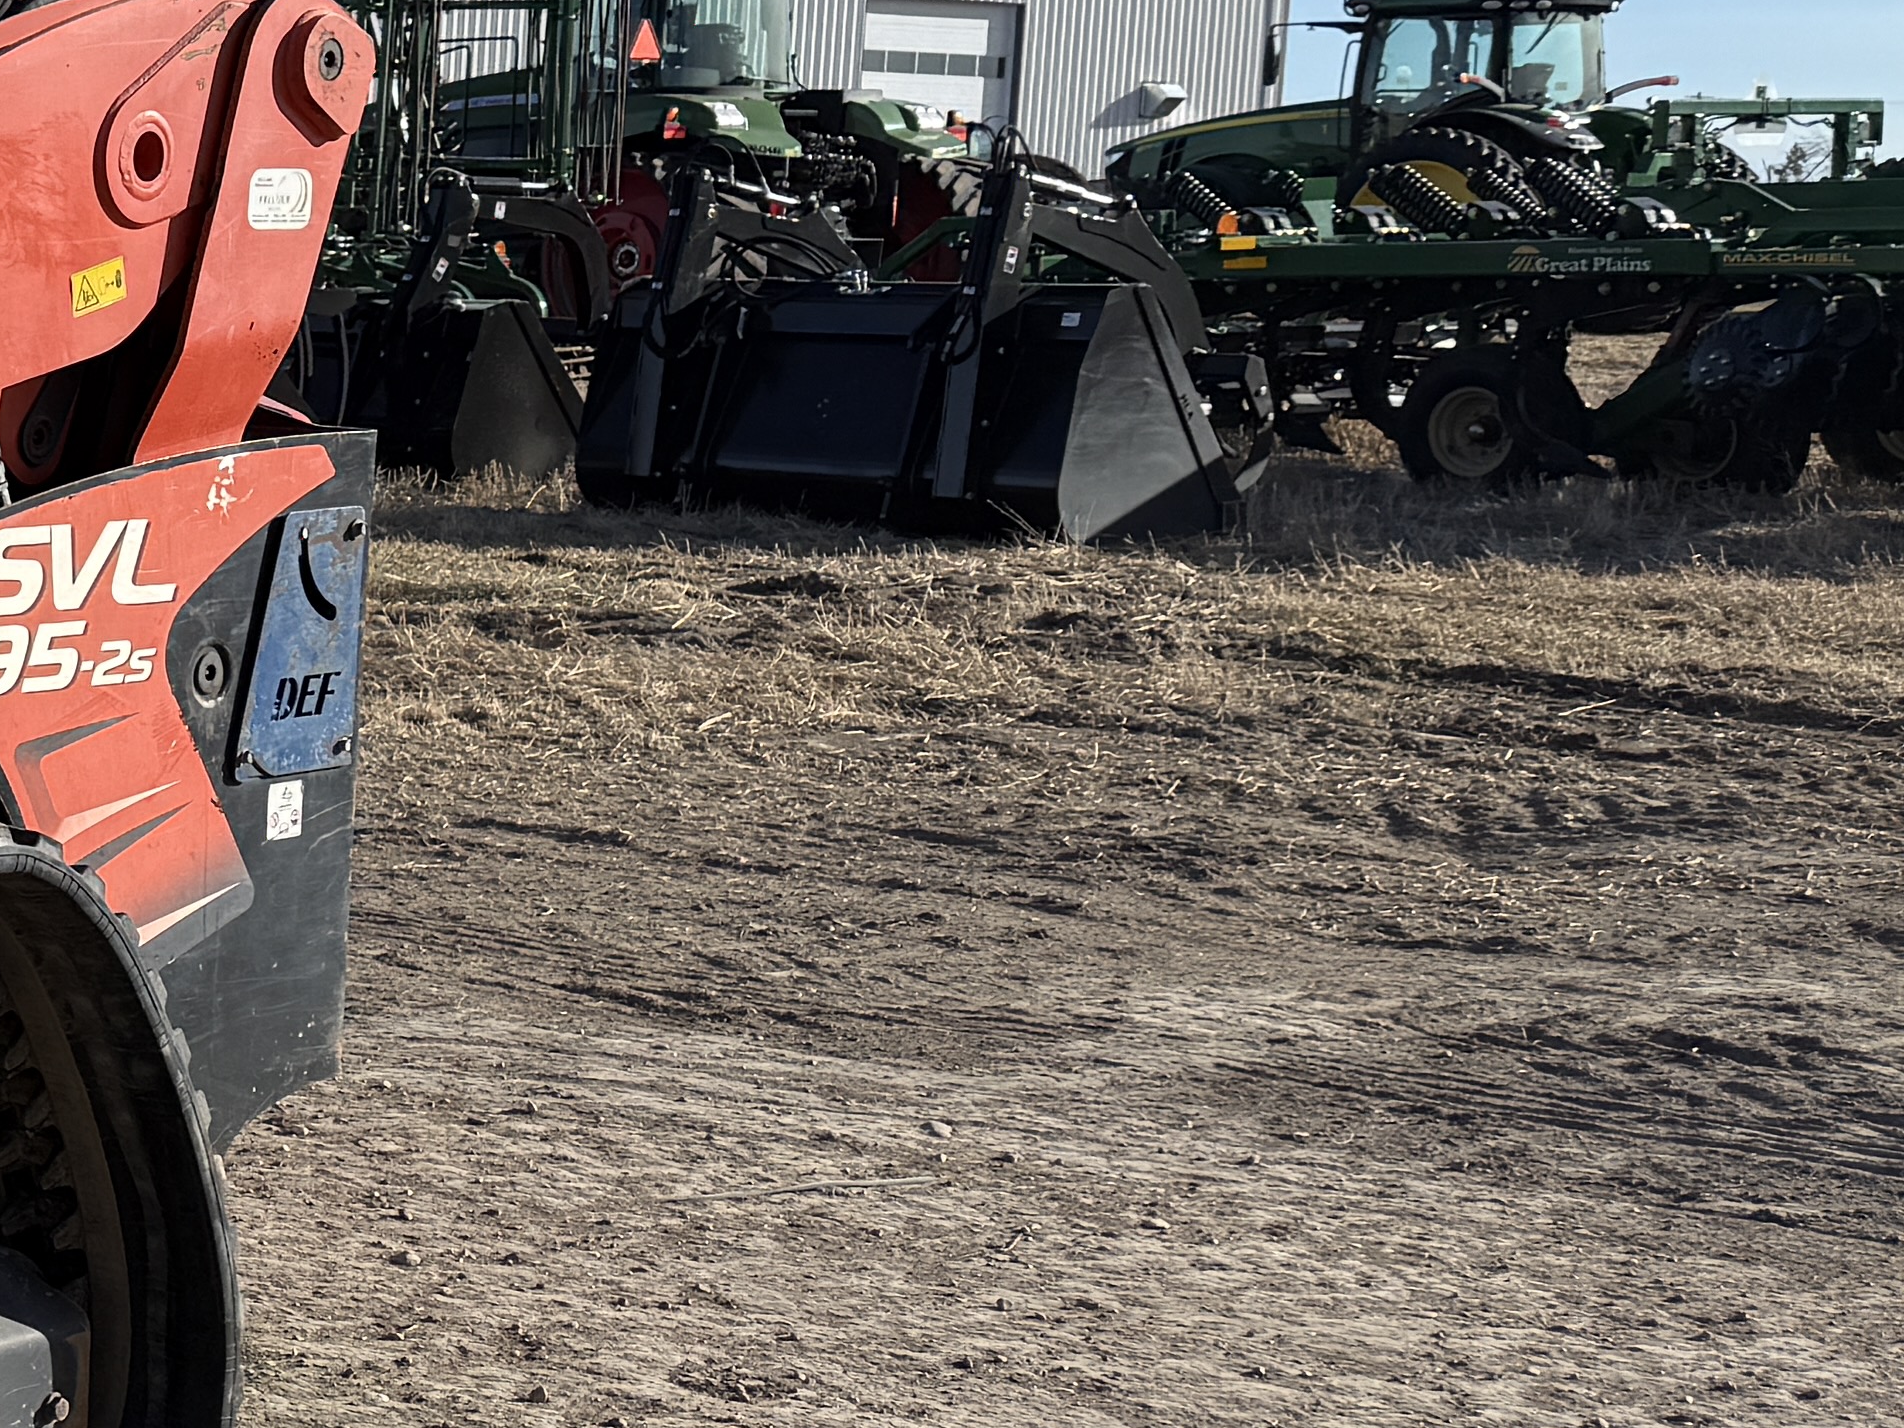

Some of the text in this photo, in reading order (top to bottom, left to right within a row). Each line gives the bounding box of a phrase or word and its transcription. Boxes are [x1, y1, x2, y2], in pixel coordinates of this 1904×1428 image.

[1535, 257, 1651, 272] Great Plains
[271, 671, 342, 722] DEF
